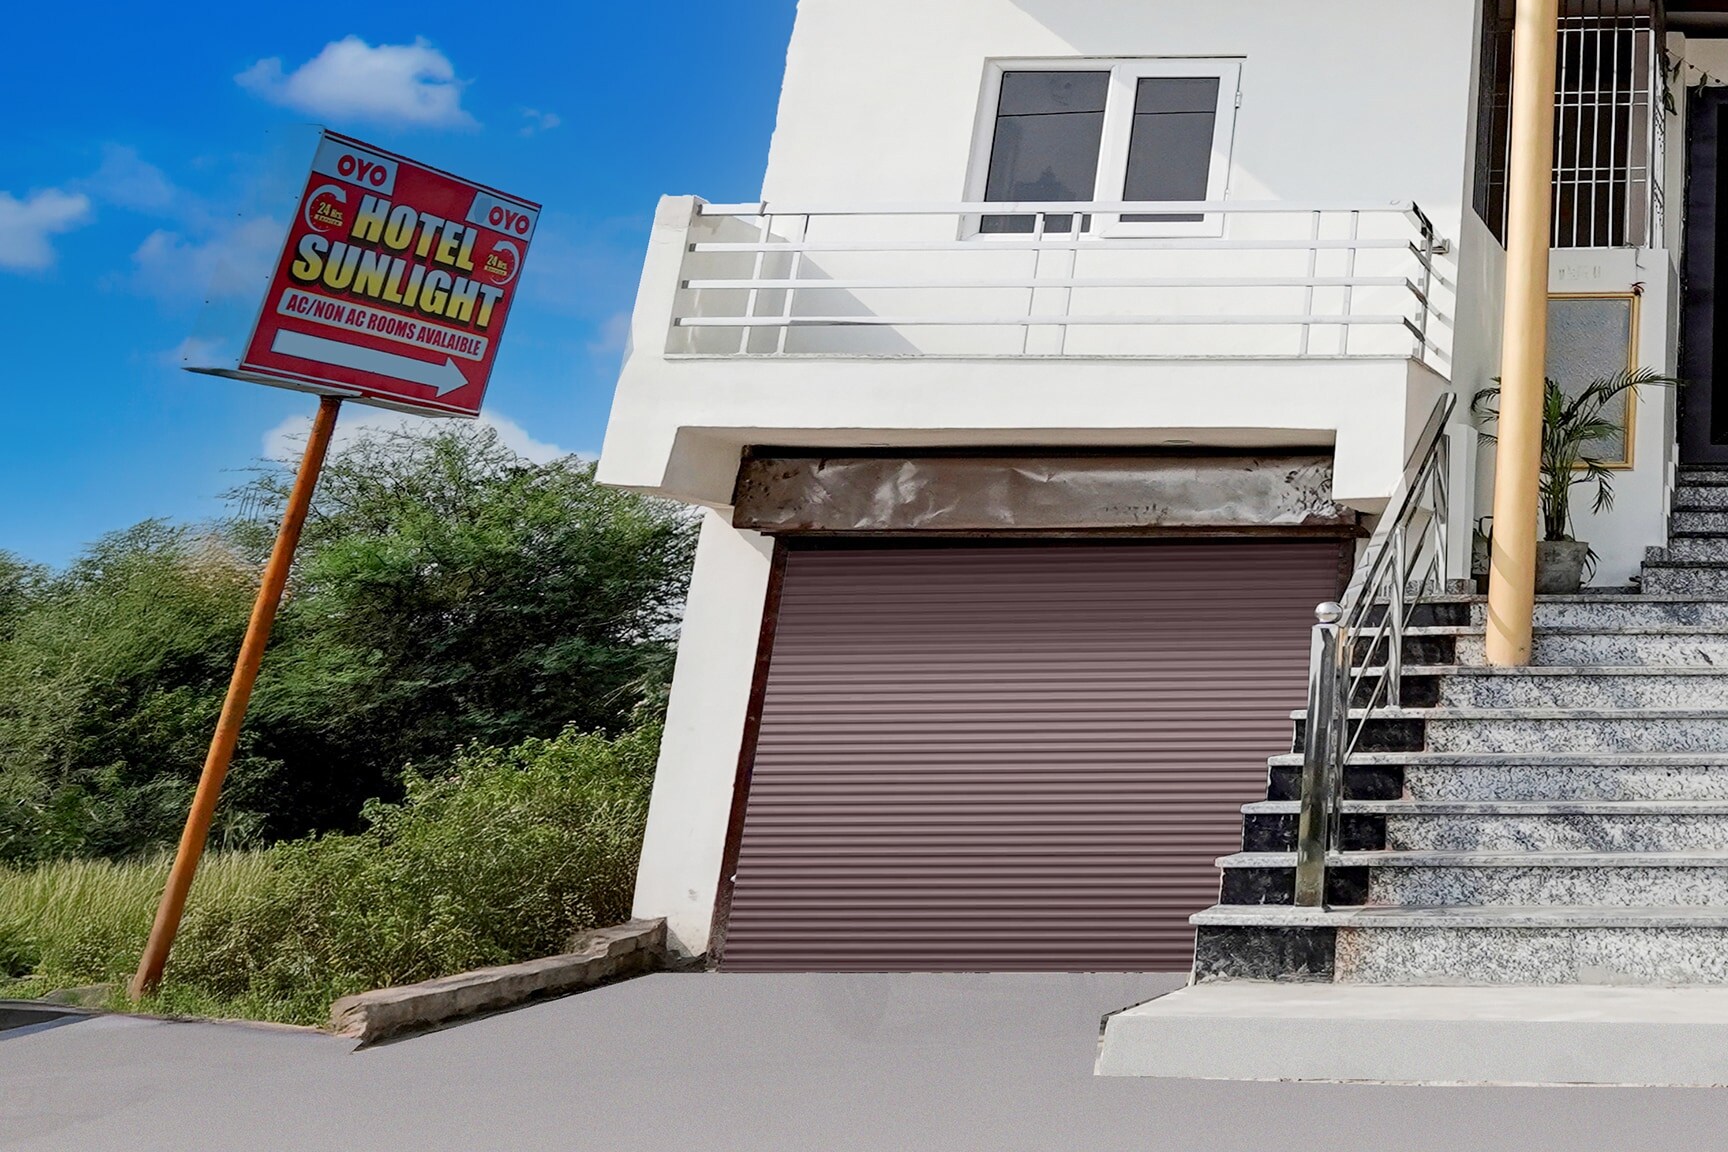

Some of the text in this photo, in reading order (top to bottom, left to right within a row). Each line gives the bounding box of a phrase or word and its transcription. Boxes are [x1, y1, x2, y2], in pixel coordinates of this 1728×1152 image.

[337, 154, 387, 187] OYO
[317, 202, 332, 216] 24
[489, 206, 530, 234] OYO
[351, 194, 479, 272] HOTEL
[487, 254, 498, 267] 24
[292, 234, 504, 328] SUNLIGHT
[286, 294, 482, 355] AC/NON AC ROOMS AVALAIBLE
